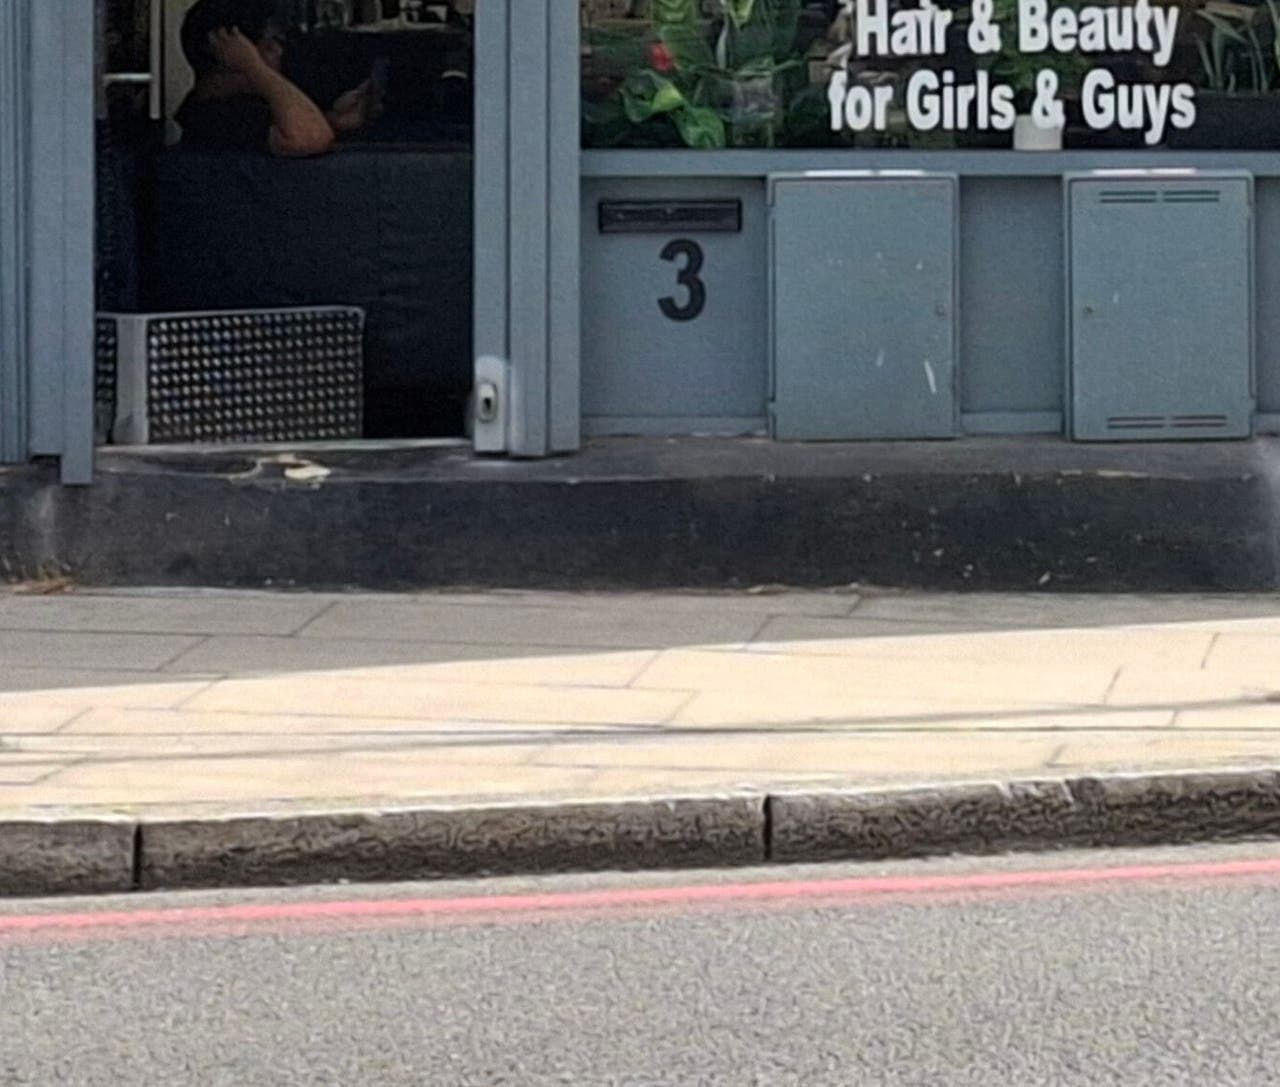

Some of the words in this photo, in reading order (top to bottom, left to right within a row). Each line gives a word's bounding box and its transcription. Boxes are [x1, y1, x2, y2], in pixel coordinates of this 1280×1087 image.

[827, 68, 894, 132] for
[906, 68, 1016, 131] Girls
[1031, 68, 1065, 130] &
[1081, 68, 1197, 145] Guys
[657, 238, 706, 323] 3
